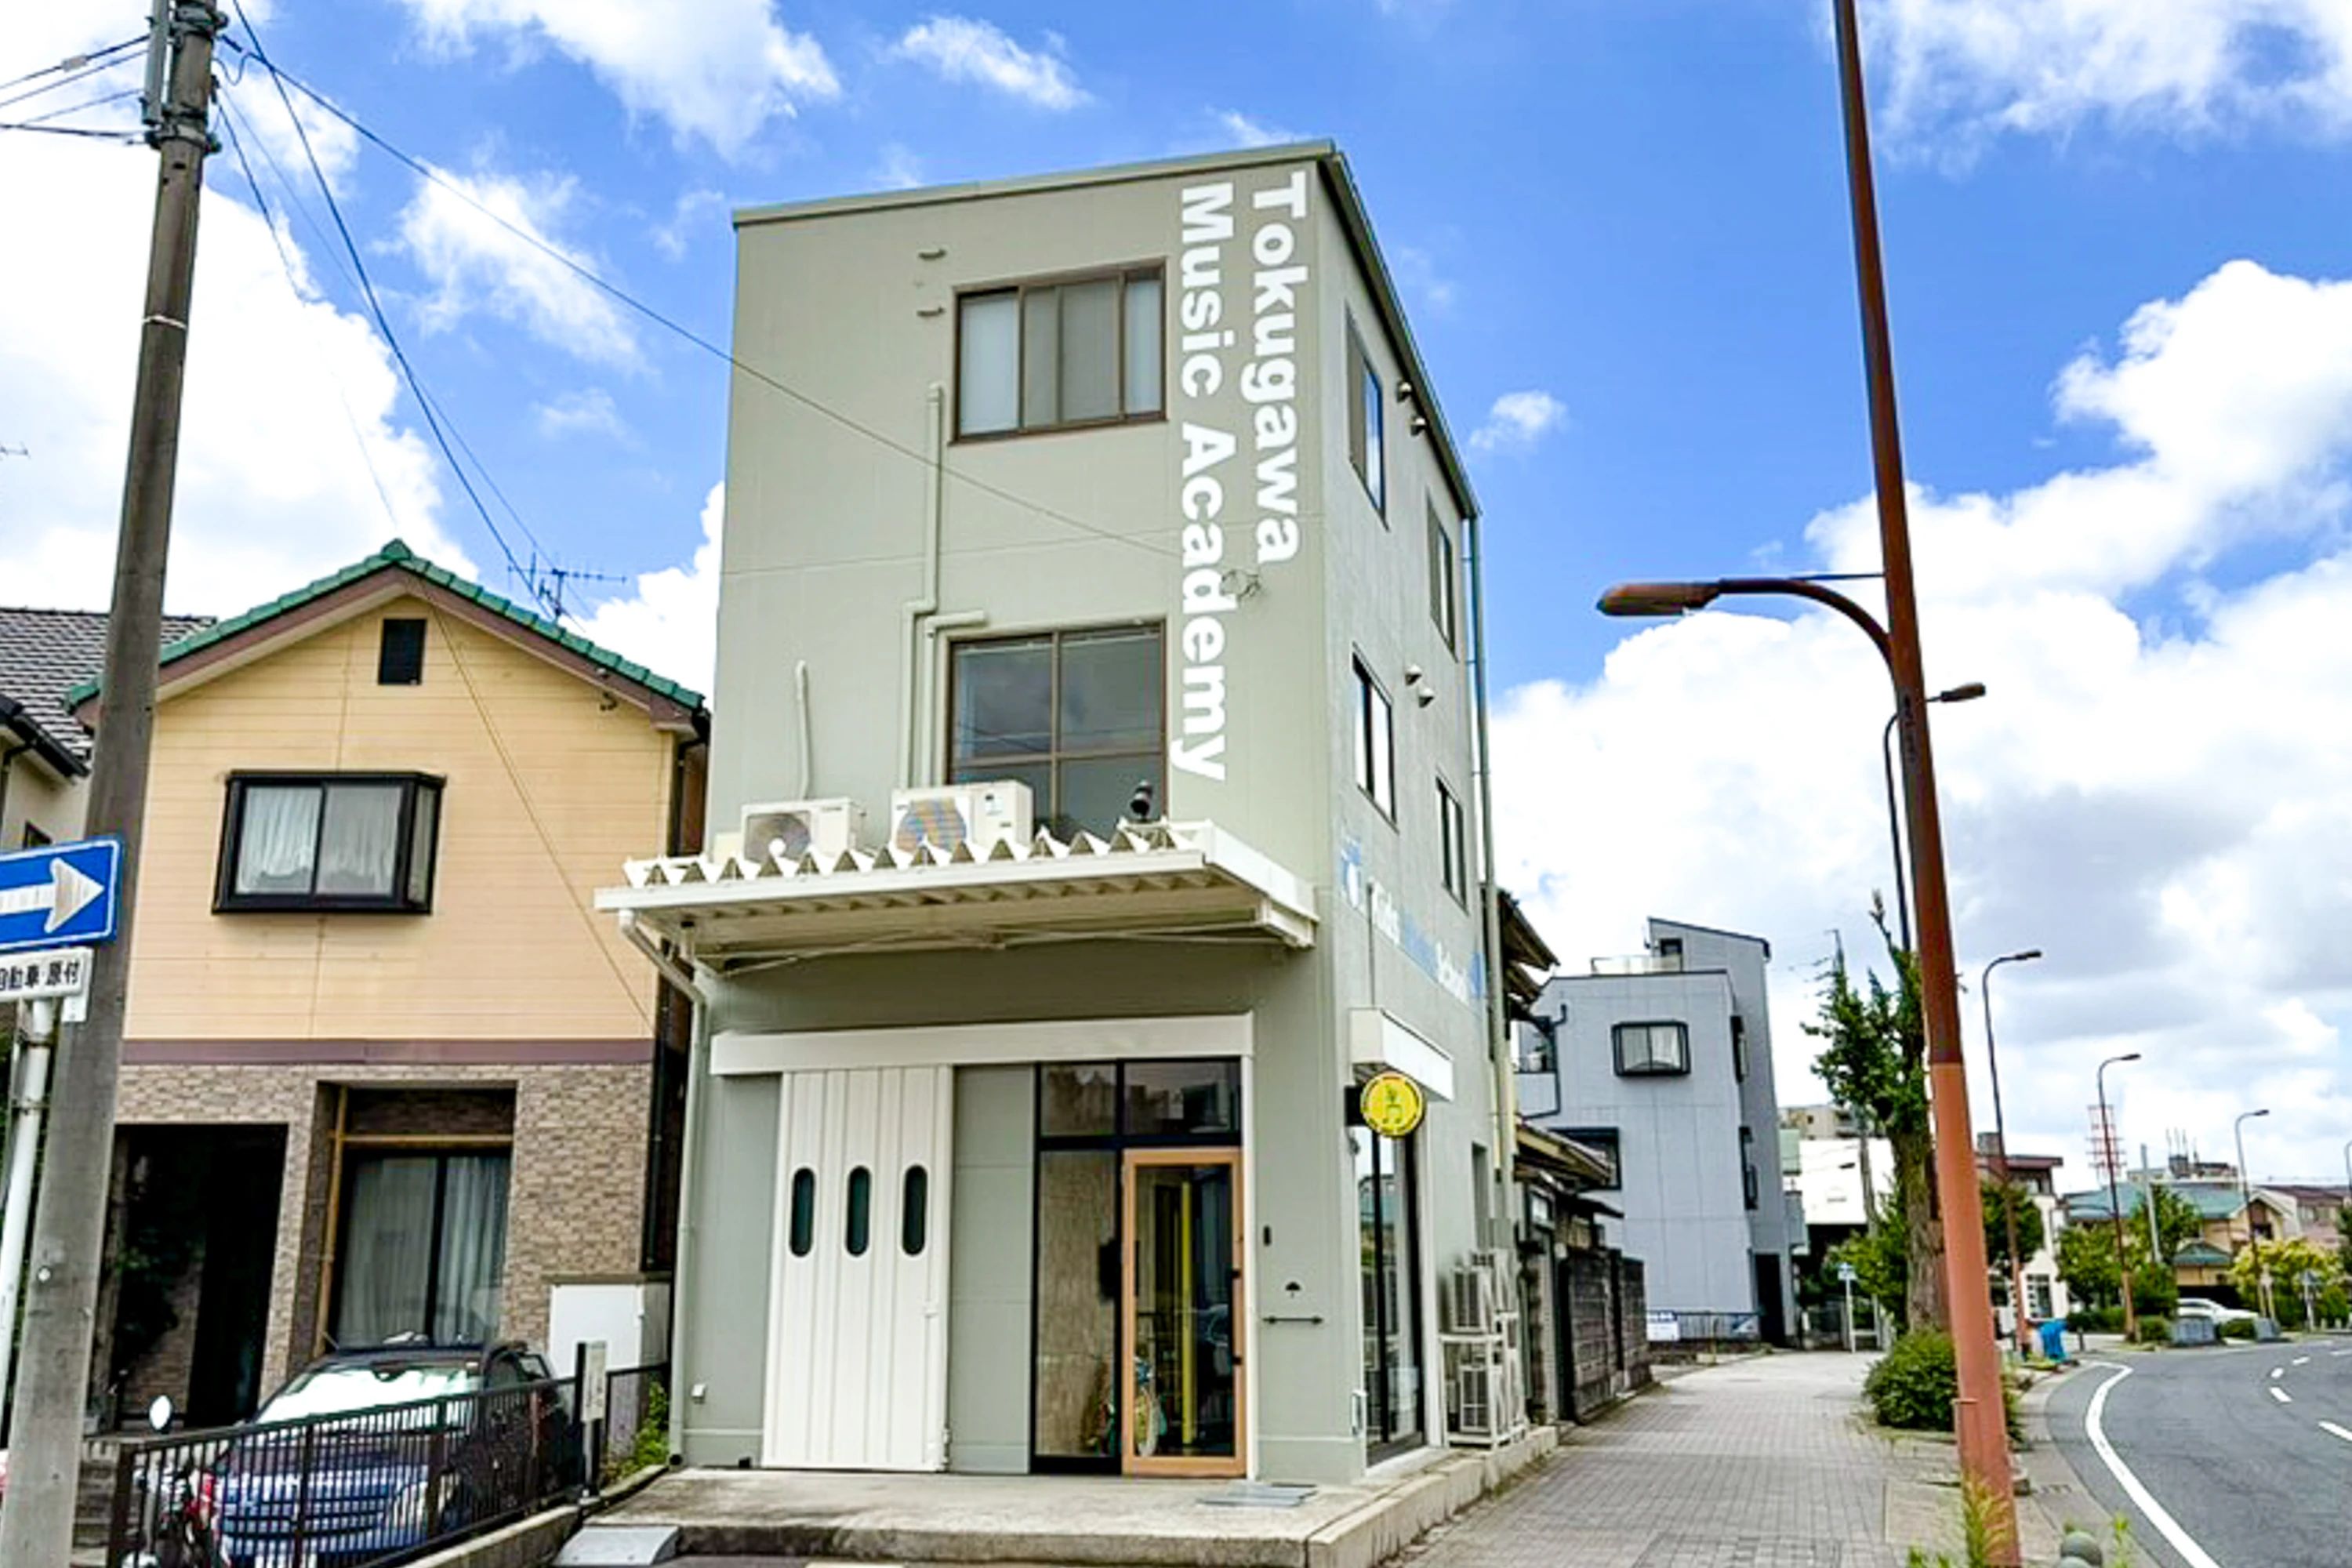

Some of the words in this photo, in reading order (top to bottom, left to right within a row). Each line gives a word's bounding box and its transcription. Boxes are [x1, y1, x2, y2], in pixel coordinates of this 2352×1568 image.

[1181, 181, 1235, 398] Music
[1241, 170, 1308, 564] Tokugawa
[1168, 422, 1236, 782] Academy
